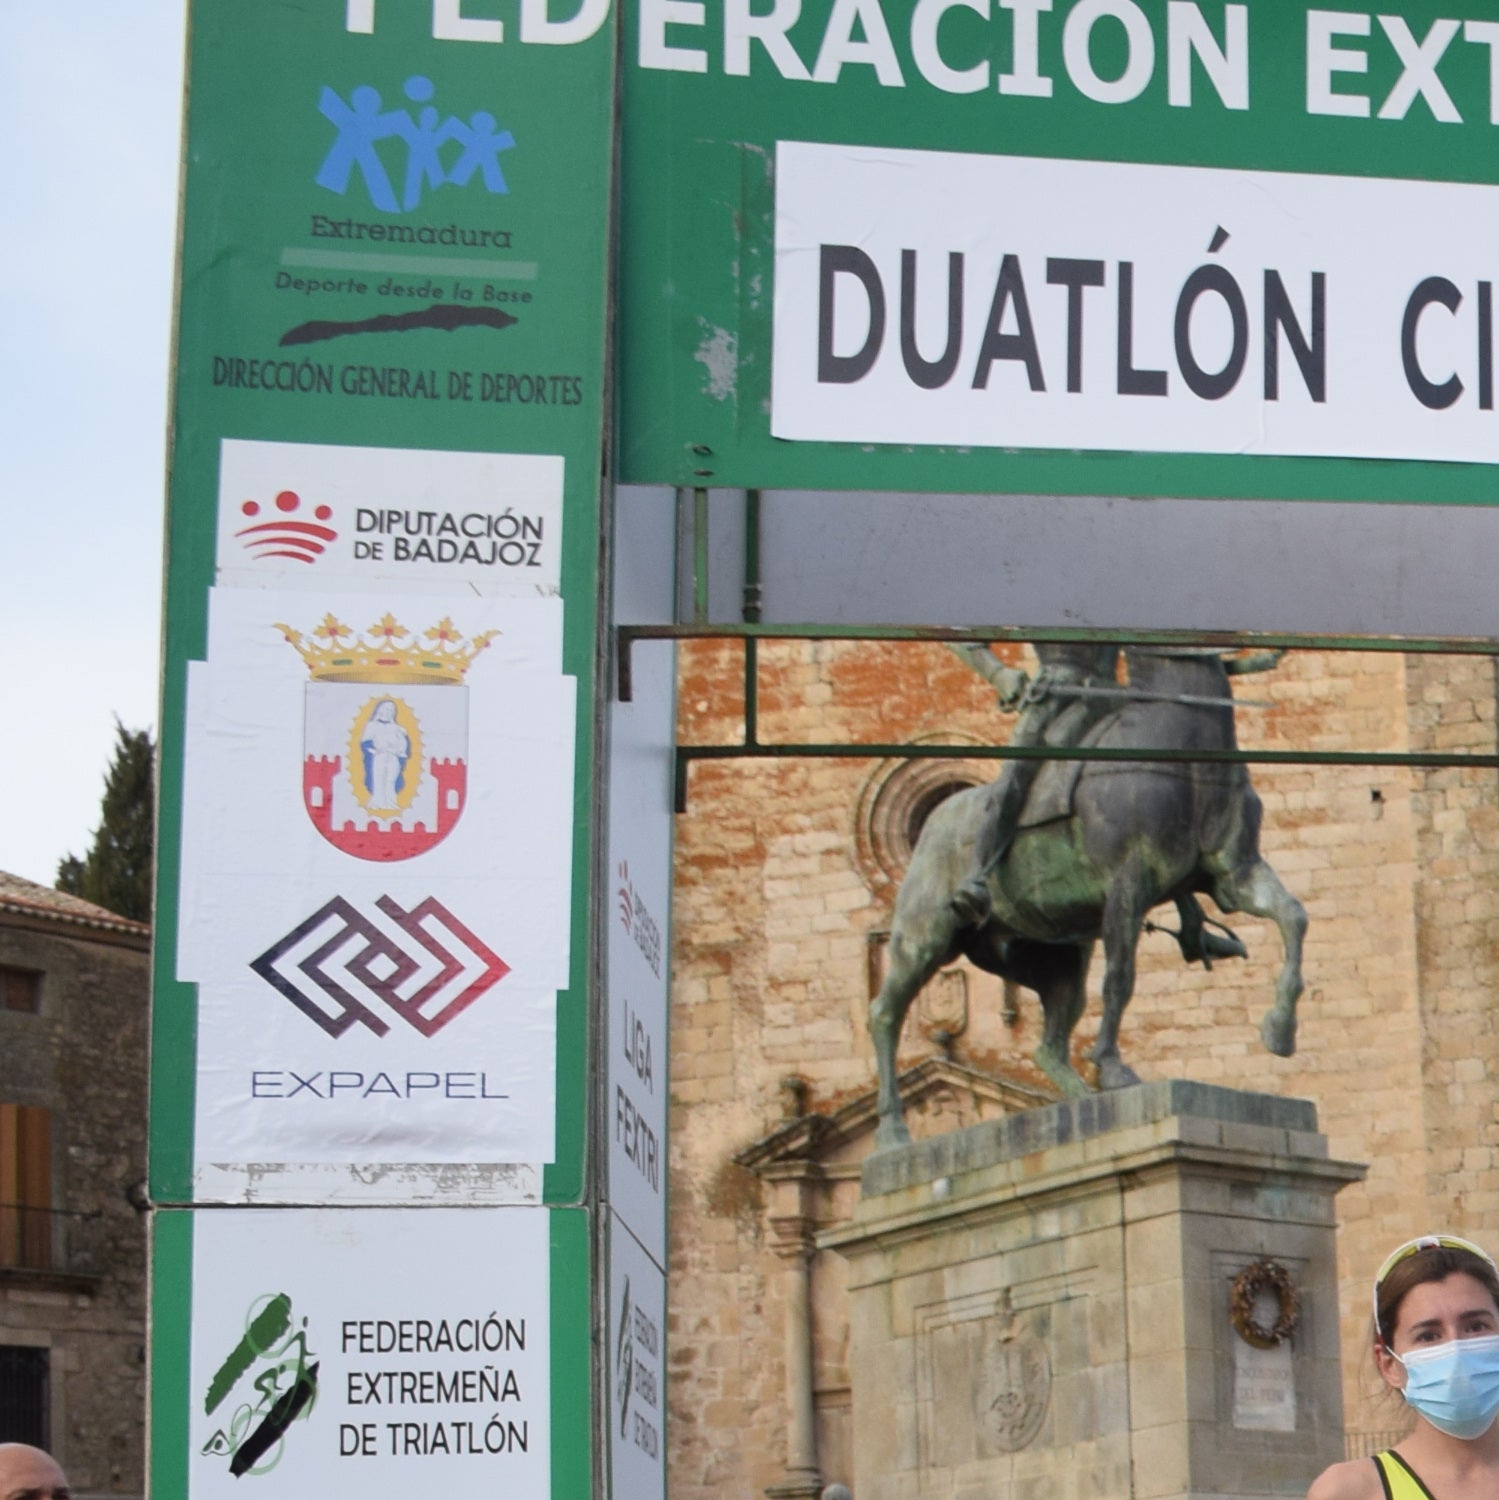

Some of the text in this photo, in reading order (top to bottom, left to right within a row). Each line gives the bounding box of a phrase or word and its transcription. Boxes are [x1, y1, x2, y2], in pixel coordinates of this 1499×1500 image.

[311, 216, 513, 248] Extremadura
[276, 272, 533, 304] Deporte desde la Base
[817, 225, 1327, 402] DUATLÓN
[213, 356, 582, 405] DIRECCIÓN GENERAL DE DEPORTES
[356, 508, 543, 540] DIPUTACIÓN
[355, 540, 541, 567] DE BADAJOZ
[624, 1000, 653, 1094] LIGA
[252, 1071, 509, 1099] EXPAPEL
[616, 1084, 659, 1193] FEXTRI
[341, 1311, 526, 1354] FEDERACIÓN
[347, 1365, 521, 1404] EXTREMEÑA
[339, 1412, 528, 1456] DE TRIATLÓN
